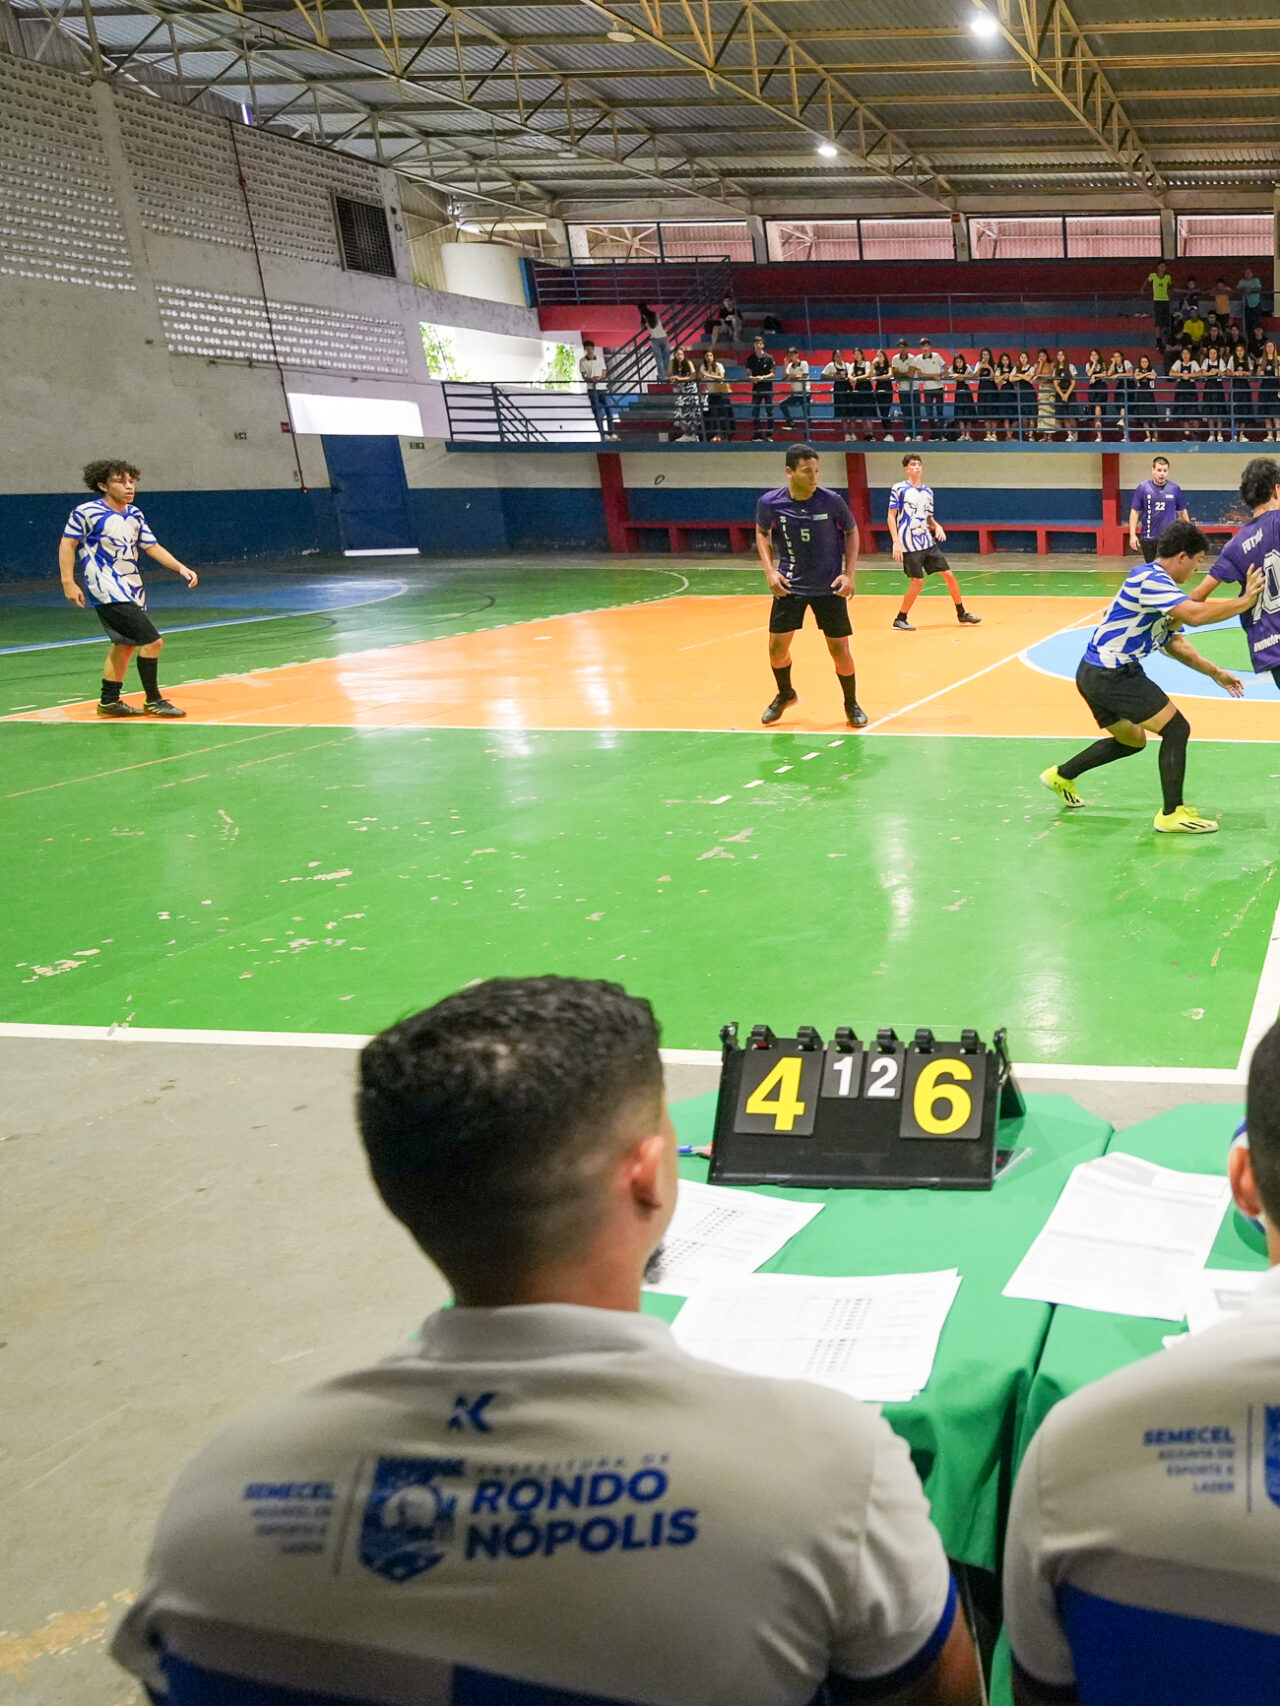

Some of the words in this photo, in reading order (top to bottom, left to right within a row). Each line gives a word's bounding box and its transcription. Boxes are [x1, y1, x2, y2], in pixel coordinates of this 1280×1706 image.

[1154, 501, 1166, 511] 22
[800, 528, 811, 542] 5
[745, 1057, 806, 1131] 4
[913, 1058, 973, 1135] 6
[1143, 1426, 1236, 1446] SEMECEL
[470, 1467, 669, 1516] RONDO
